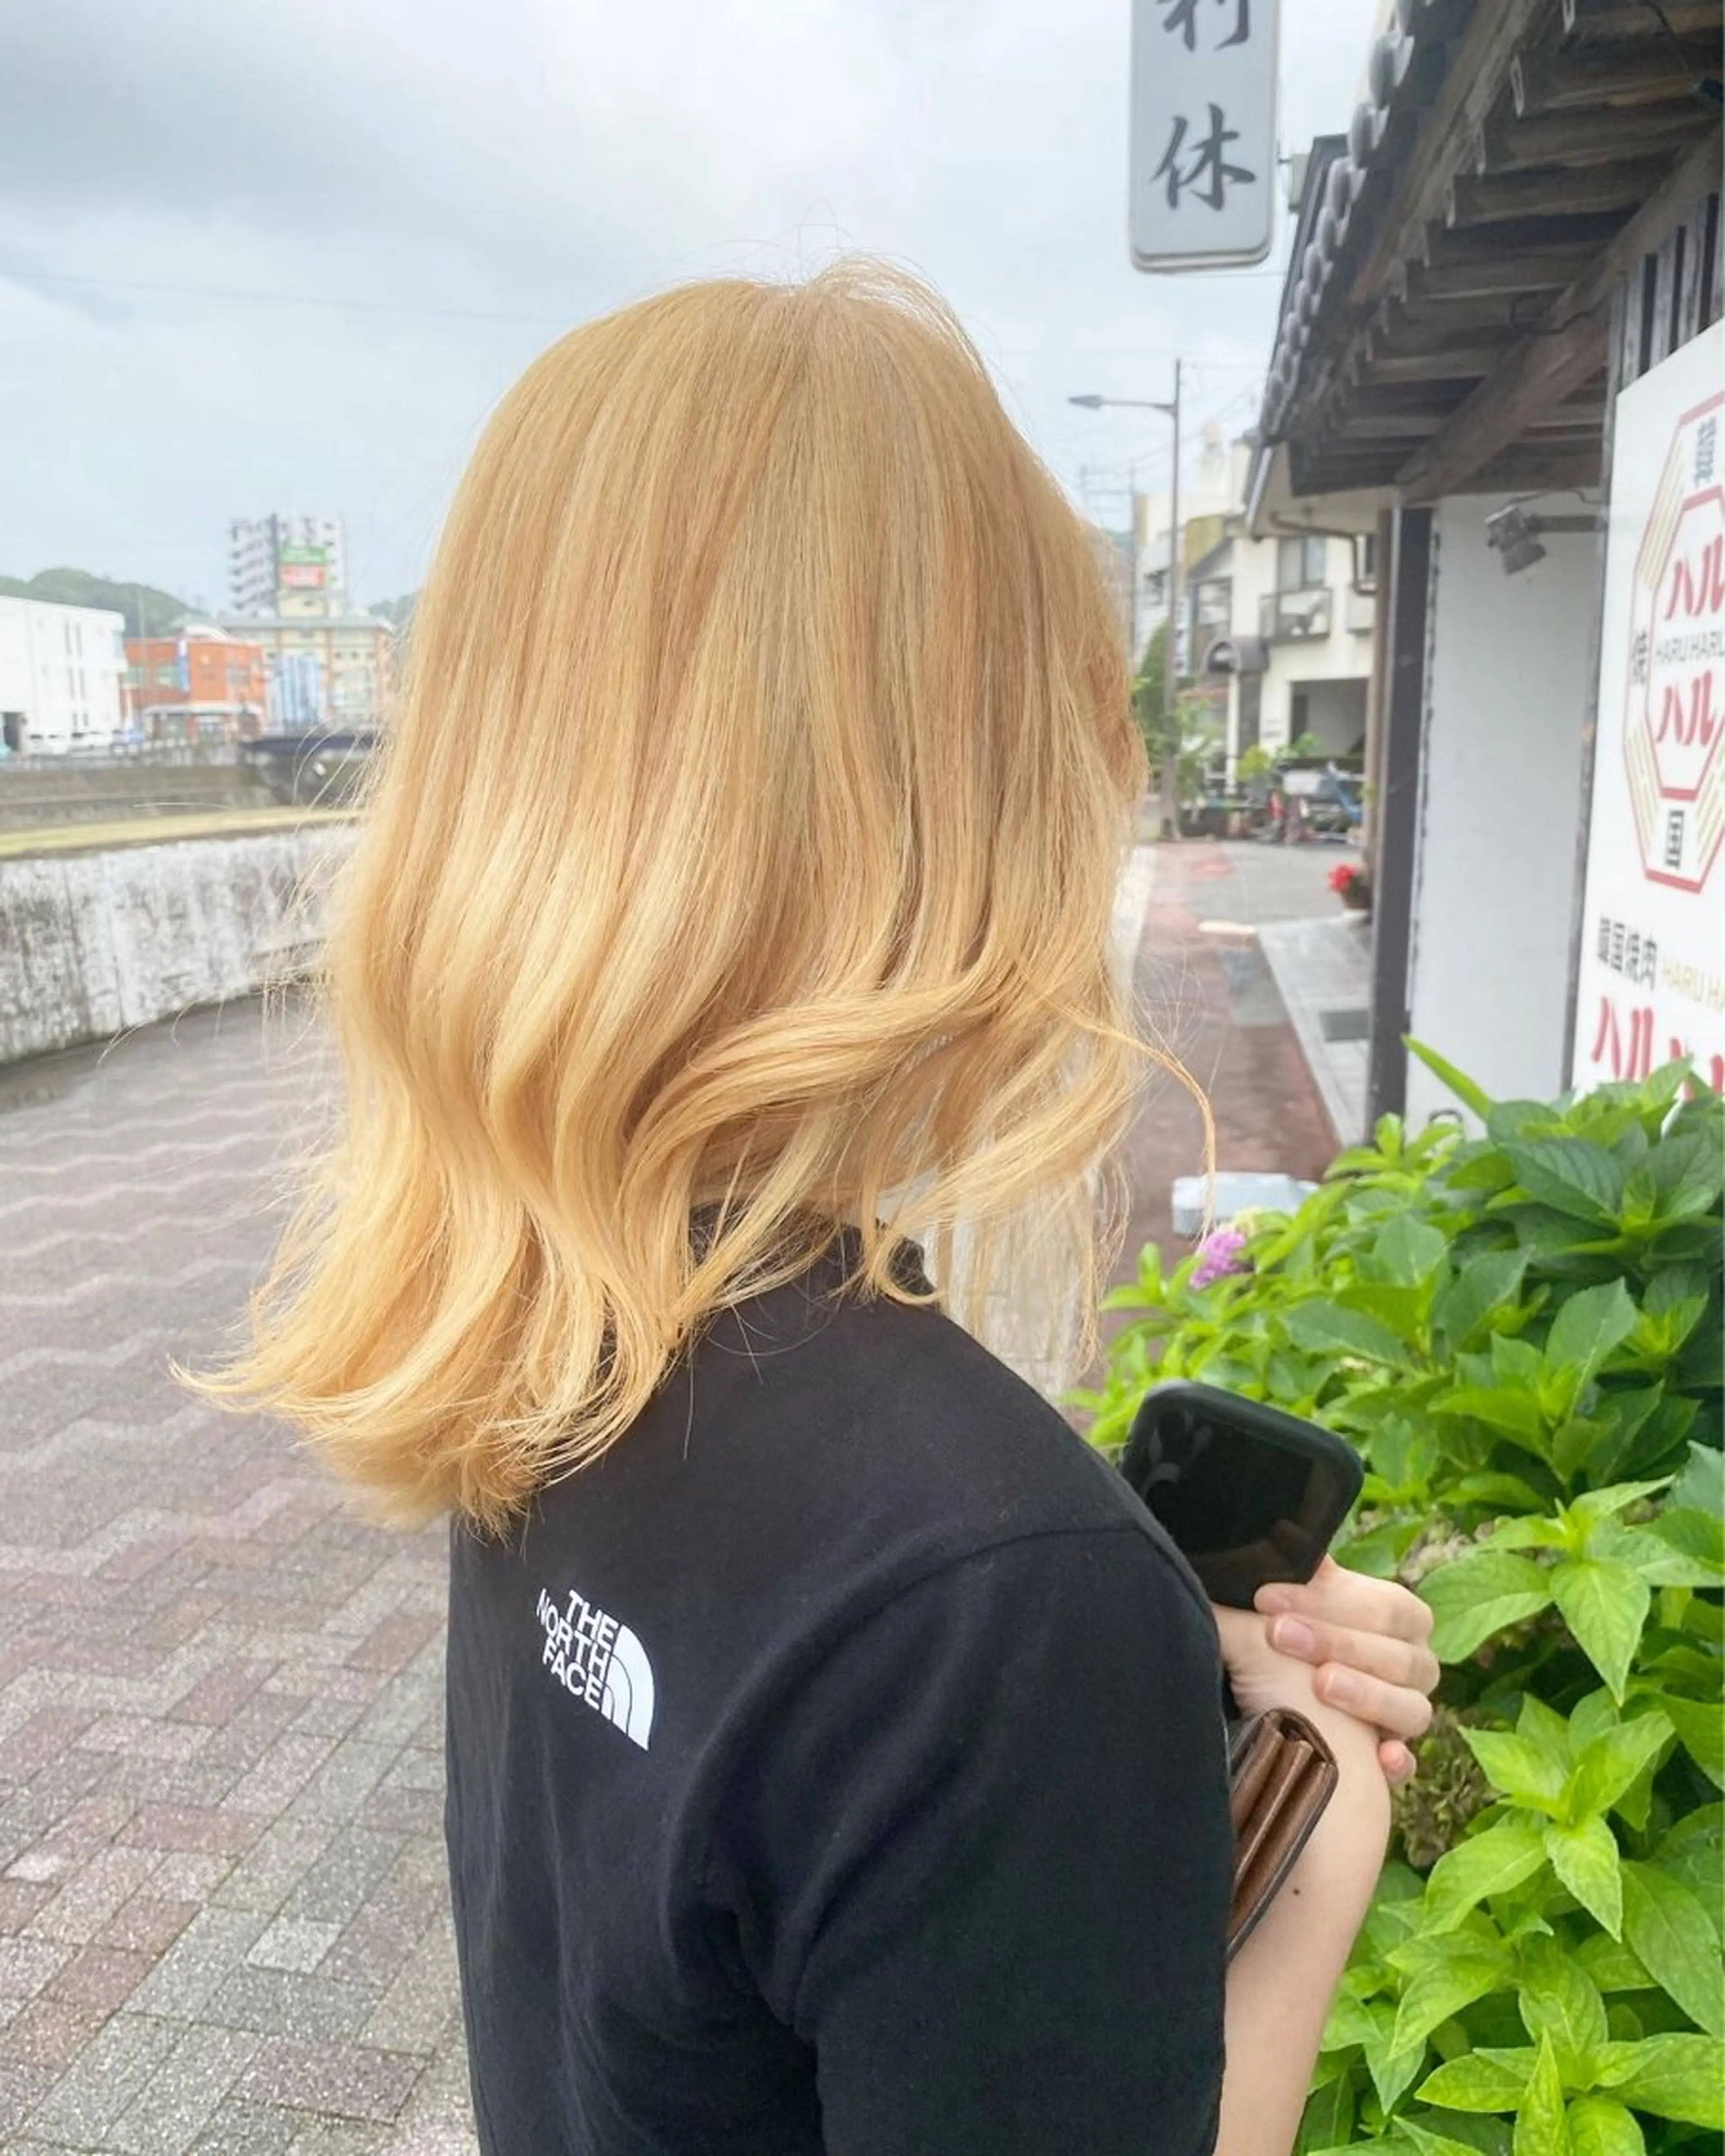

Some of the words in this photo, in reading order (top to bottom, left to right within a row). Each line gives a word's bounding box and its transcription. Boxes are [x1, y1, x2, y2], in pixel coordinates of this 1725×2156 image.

[536, 1588, 609, 1682] NORTH
[566, 1589, 619, 1652] THE
[543, 1636, 602, 1711] FACE
